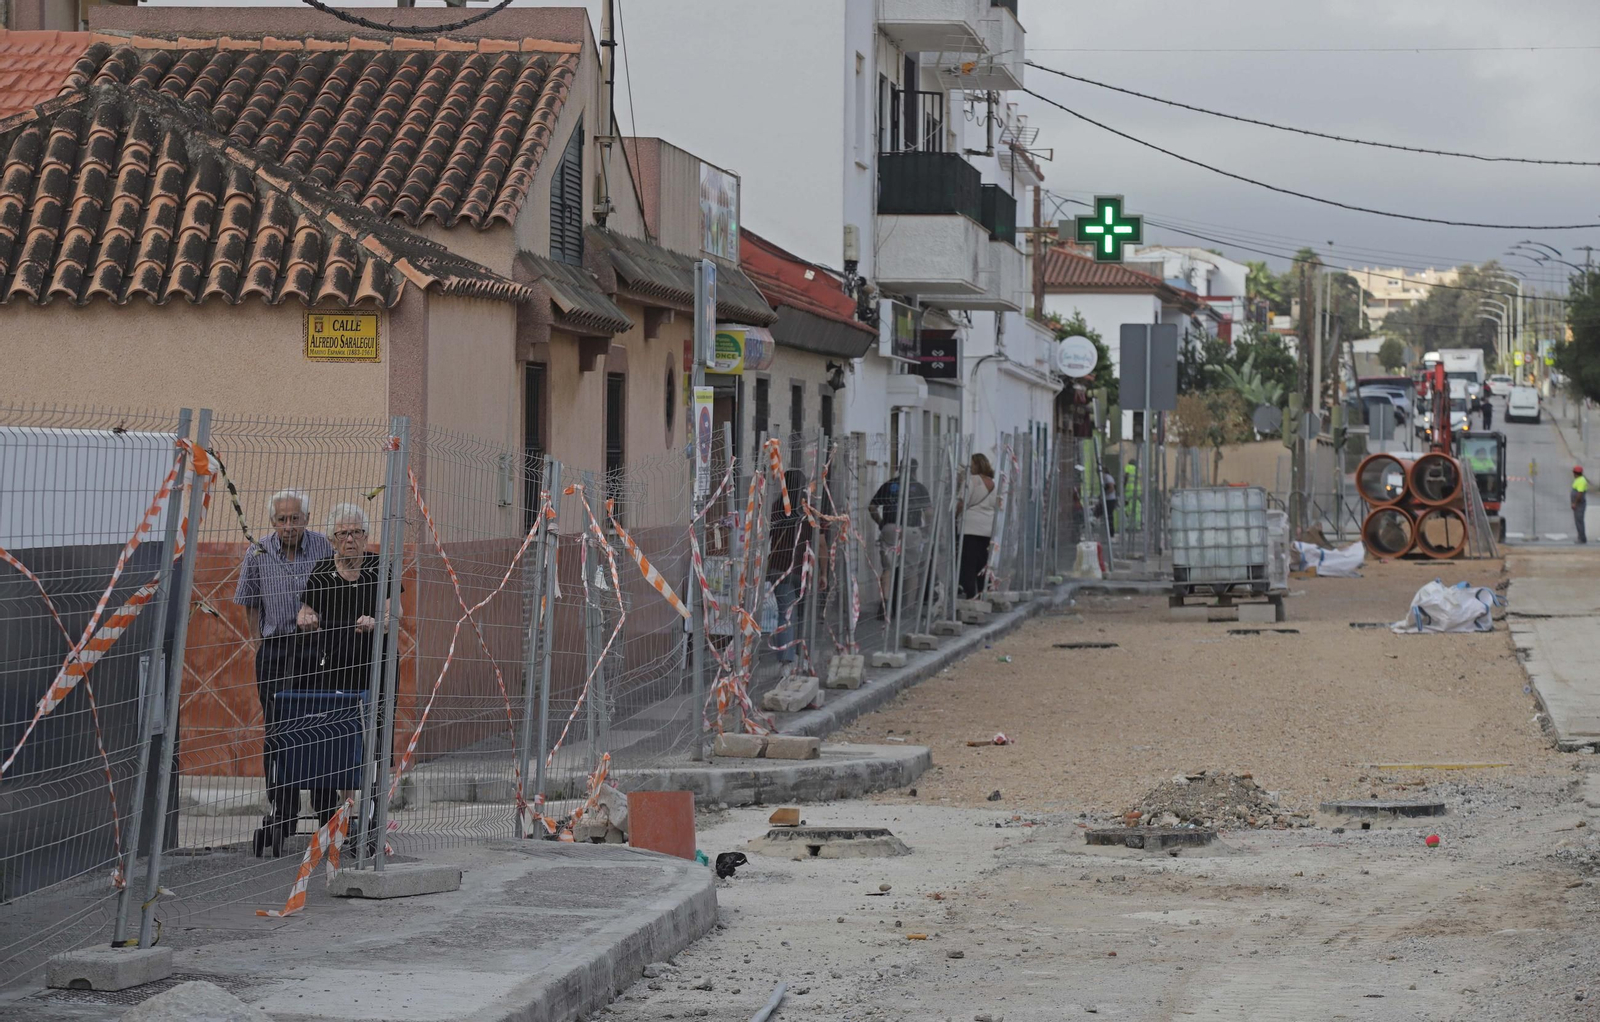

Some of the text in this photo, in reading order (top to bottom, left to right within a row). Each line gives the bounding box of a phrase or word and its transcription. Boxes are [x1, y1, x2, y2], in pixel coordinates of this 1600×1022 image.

[332, 319, 362, 332] CALLE
[310, 334, 375, 349] ALFREDO SARALEGUI
[715, 352, 737, 360] ONCE
